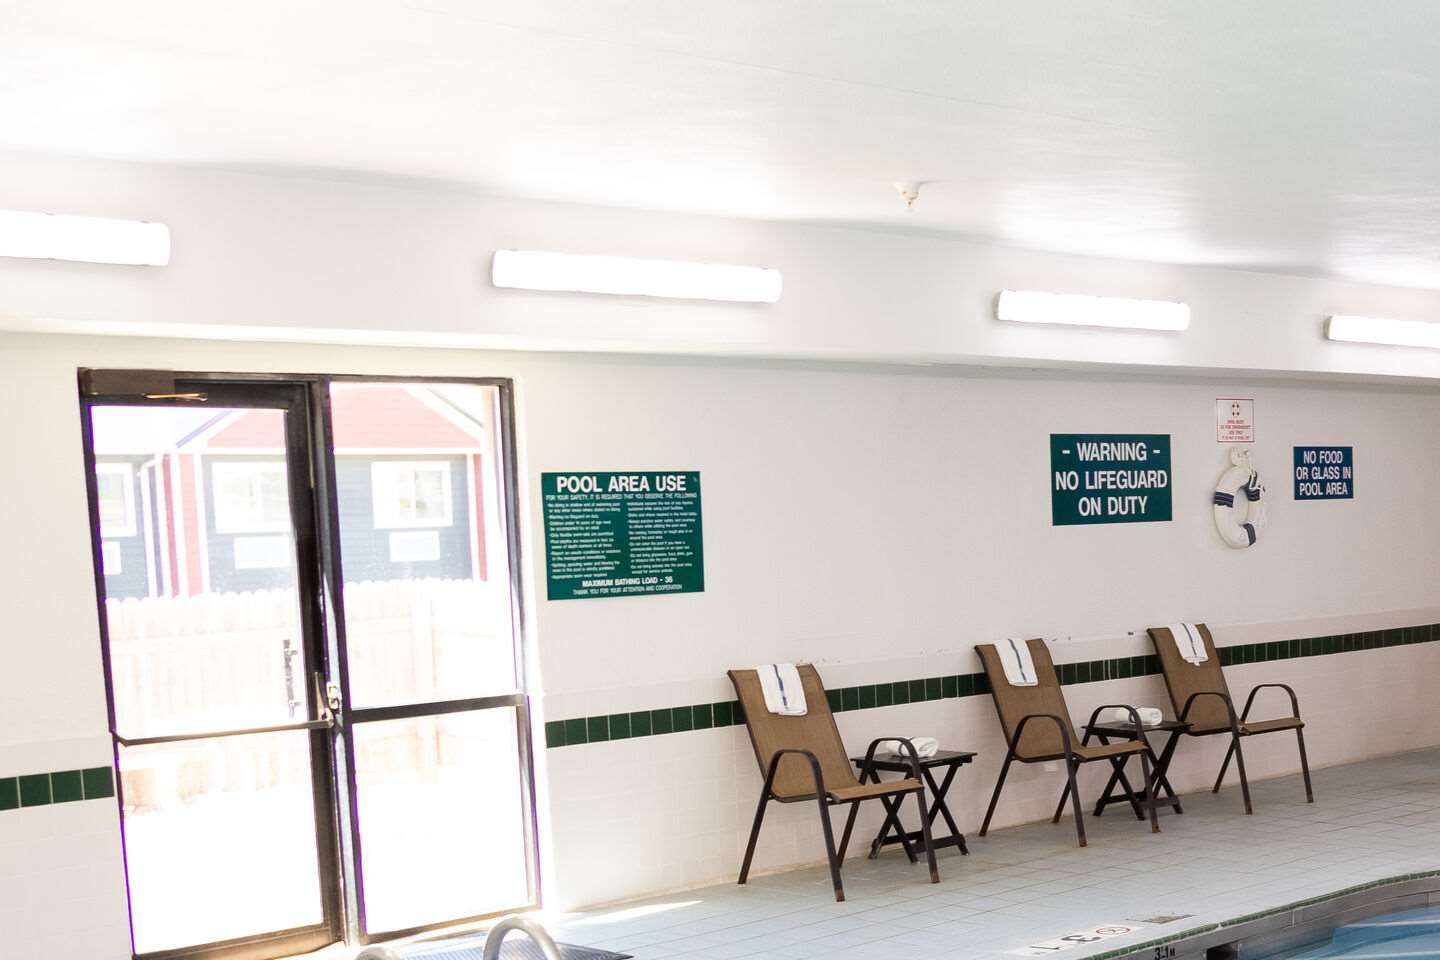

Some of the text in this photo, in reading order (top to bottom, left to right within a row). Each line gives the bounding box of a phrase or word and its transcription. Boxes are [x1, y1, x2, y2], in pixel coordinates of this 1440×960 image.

[1076, 442, 1147, 462] WARNING
[1303, 450, 1343, 464] NO FOOD
[1055, 470, 1167, 491] NO LIFEGUARD
[1296, 466, 1351, 480] OR GLASS IN
[556, 475, 687, 493] POOL AREA USE
[1299, 481, 1349, 496] POOL AREA
[1078, 495, 1148, 516] ON DUTY
[582, 579, 613, 587] MAXIMUM
[641, 577, 658, 585] LOAD
